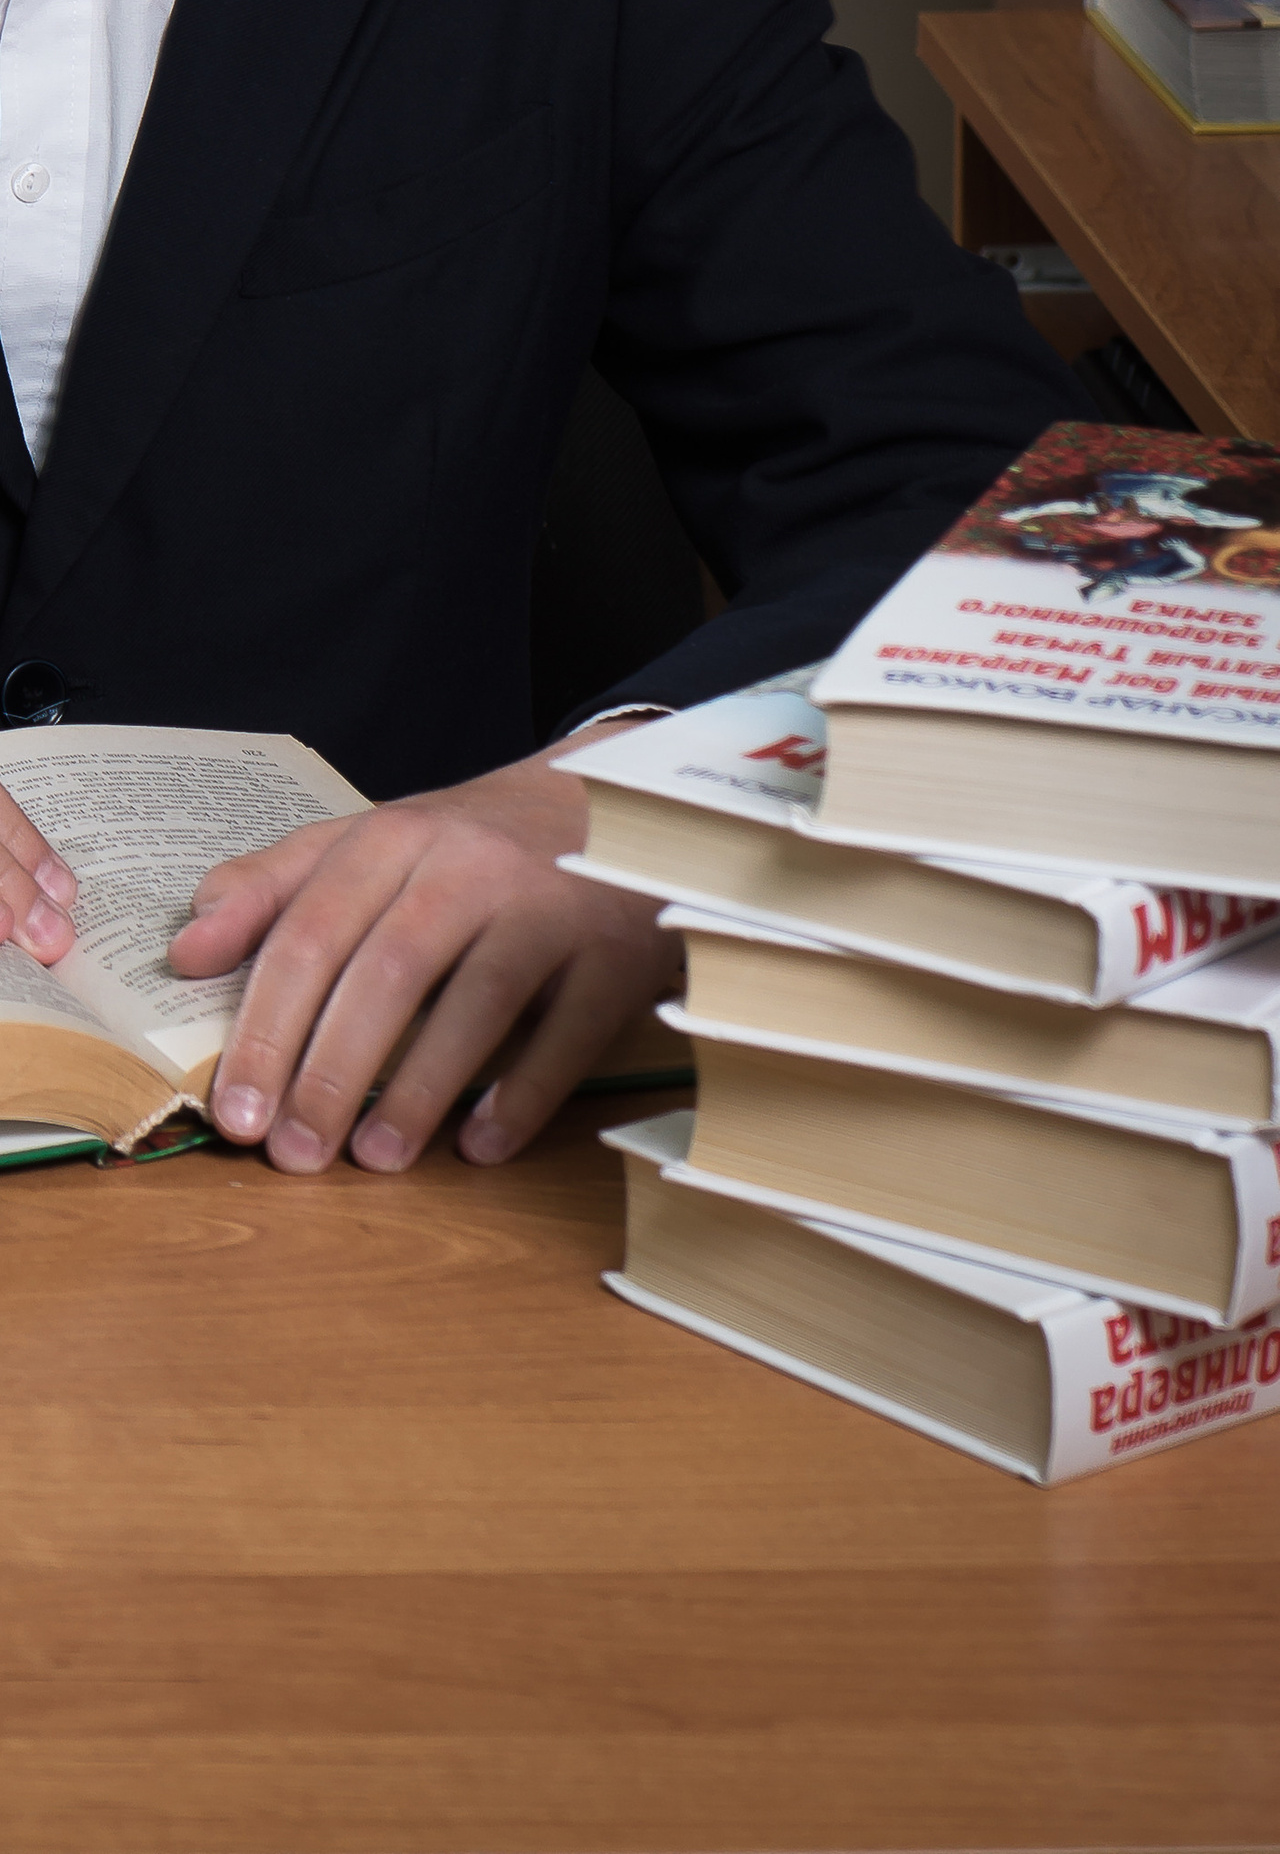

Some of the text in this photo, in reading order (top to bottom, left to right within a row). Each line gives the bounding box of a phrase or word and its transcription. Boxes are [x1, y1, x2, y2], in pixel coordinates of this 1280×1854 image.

[956, 598, 1266, 650] заброшенного
[1127, 598, 1264, 628] замка
[873, 643, 1095, 685] Марранов
[991, 630, 1131, 664] Туман
[882, 669, 1079, 705] ВОЛКОВ
[1099, 670, 1179, 696] бог
[241, 749, 267, 757] 220
[1089, 1329, 1280, 1436] Оливера
